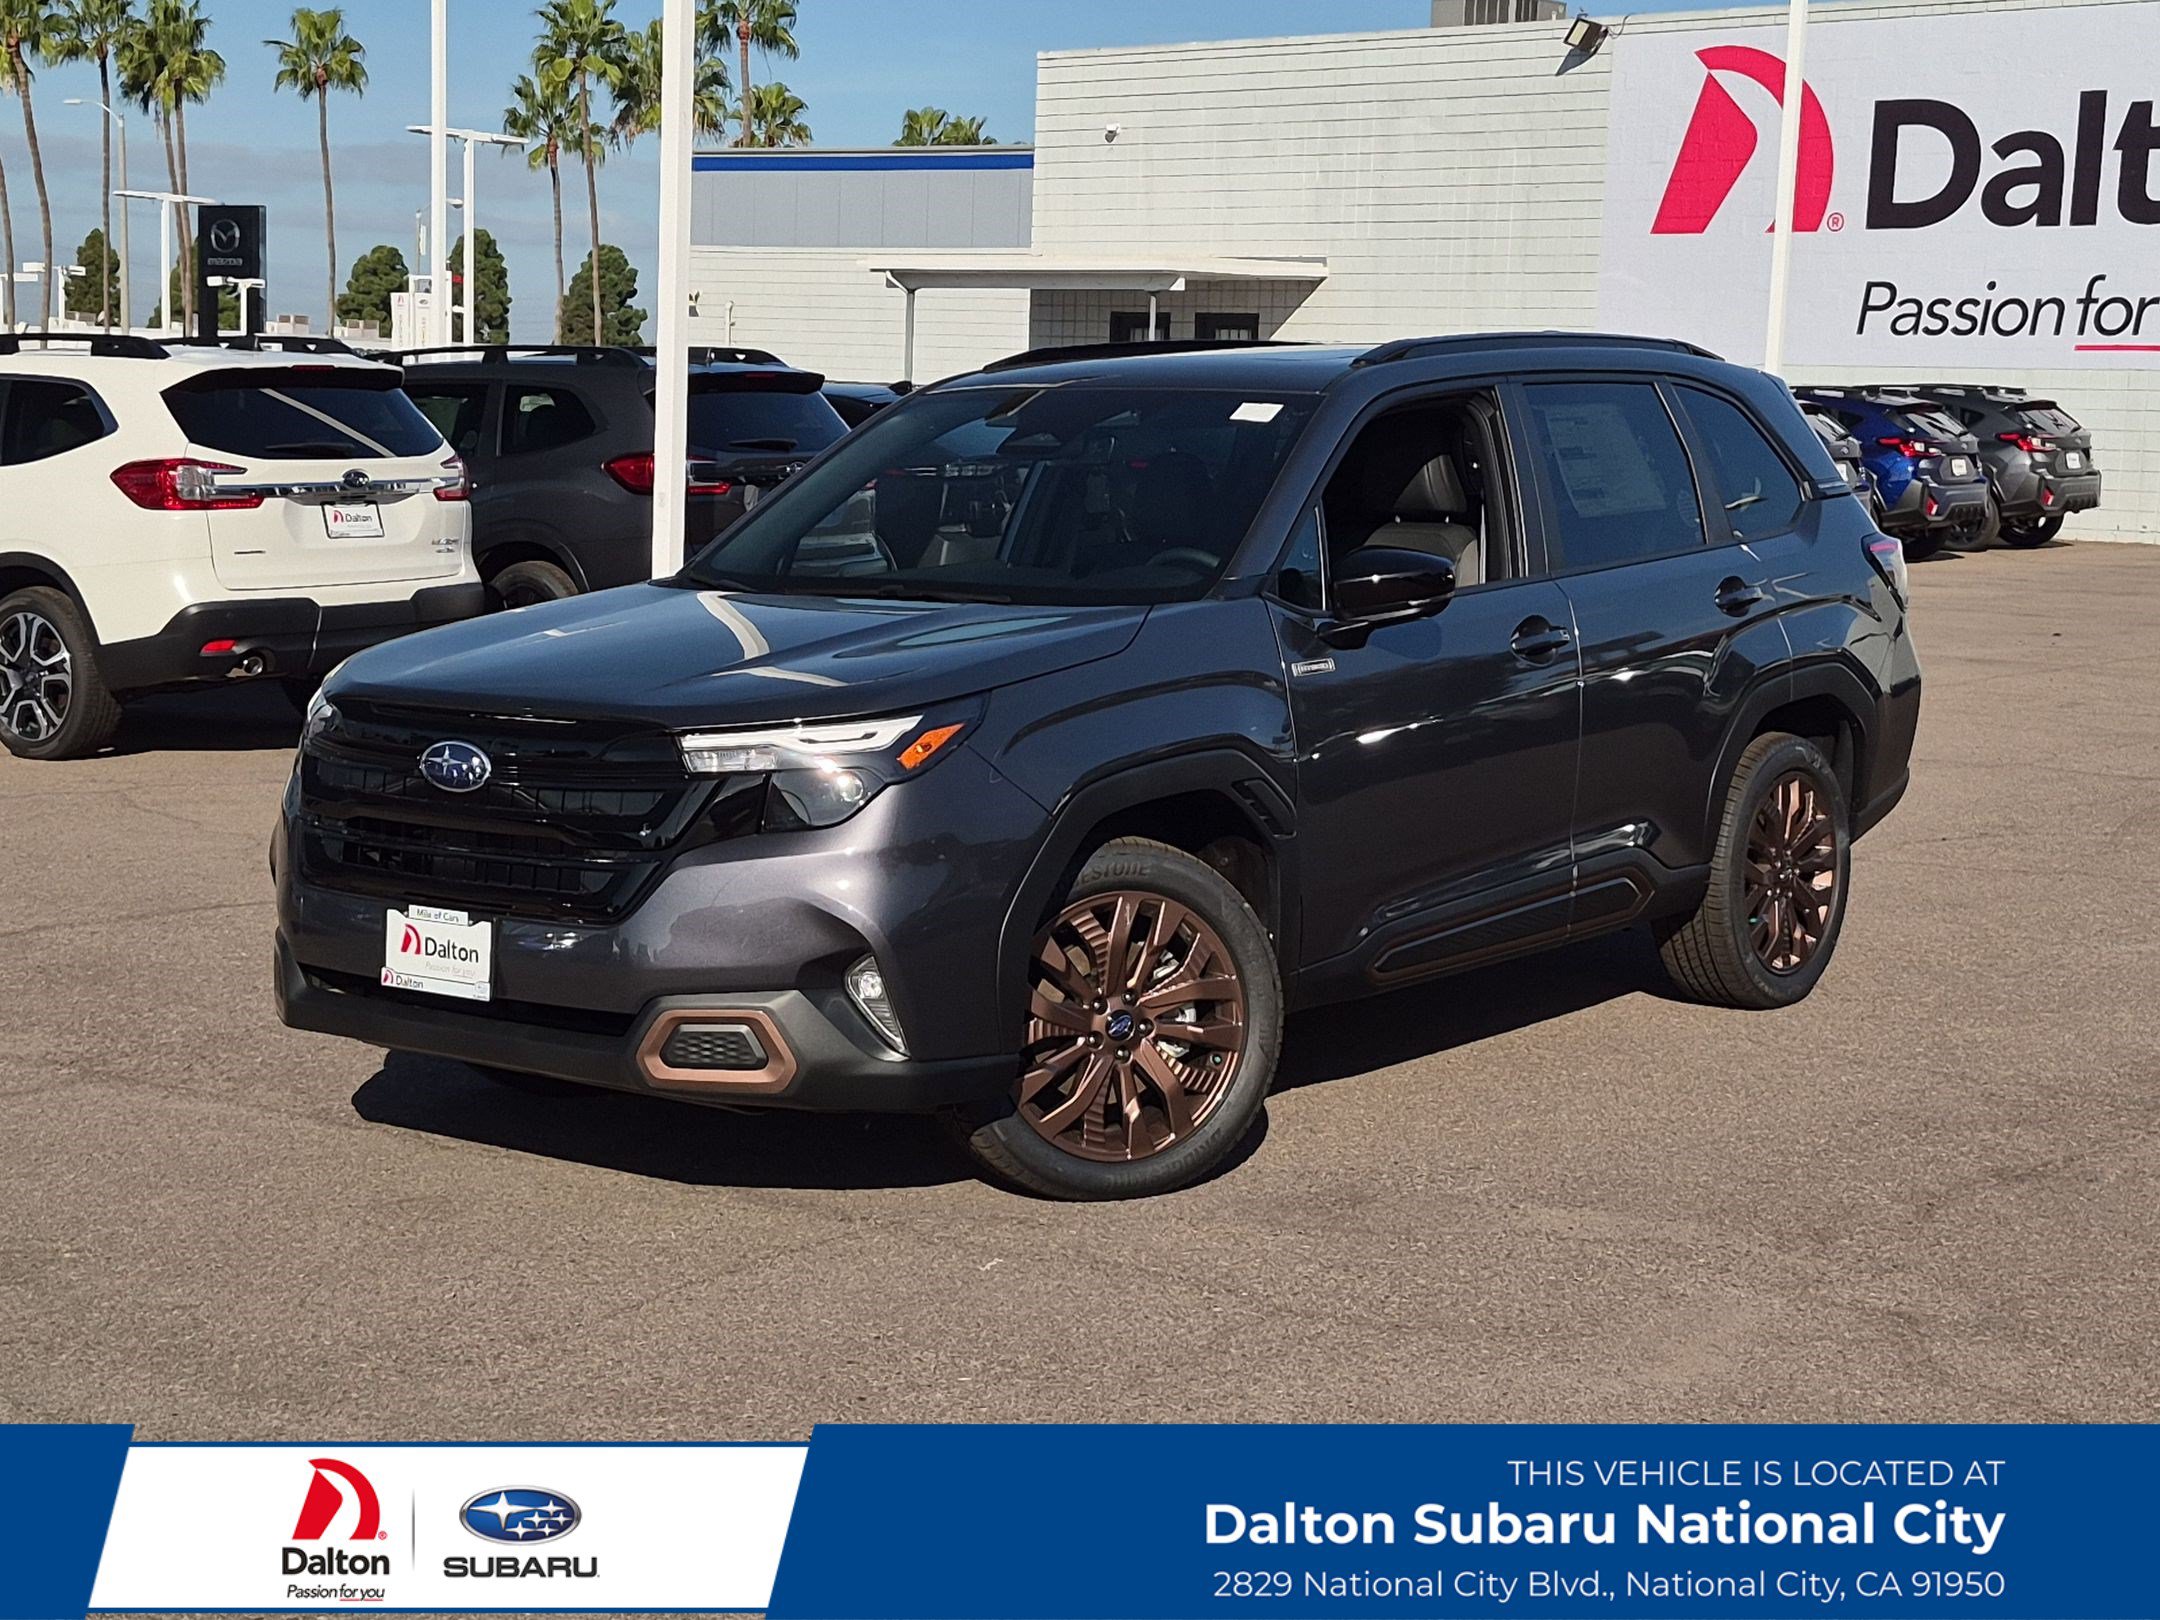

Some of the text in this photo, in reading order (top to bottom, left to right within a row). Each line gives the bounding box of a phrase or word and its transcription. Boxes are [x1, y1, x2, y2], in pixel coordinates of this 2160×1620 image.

[1856, 274, 2160, 337] Passion for
[345, 513, 373, 523] Dalton
[416, 908, 459, 923] Mile of Cars
[425, 936, 479, 963] Dalton
[395, 975, 424, 989] Dalton
